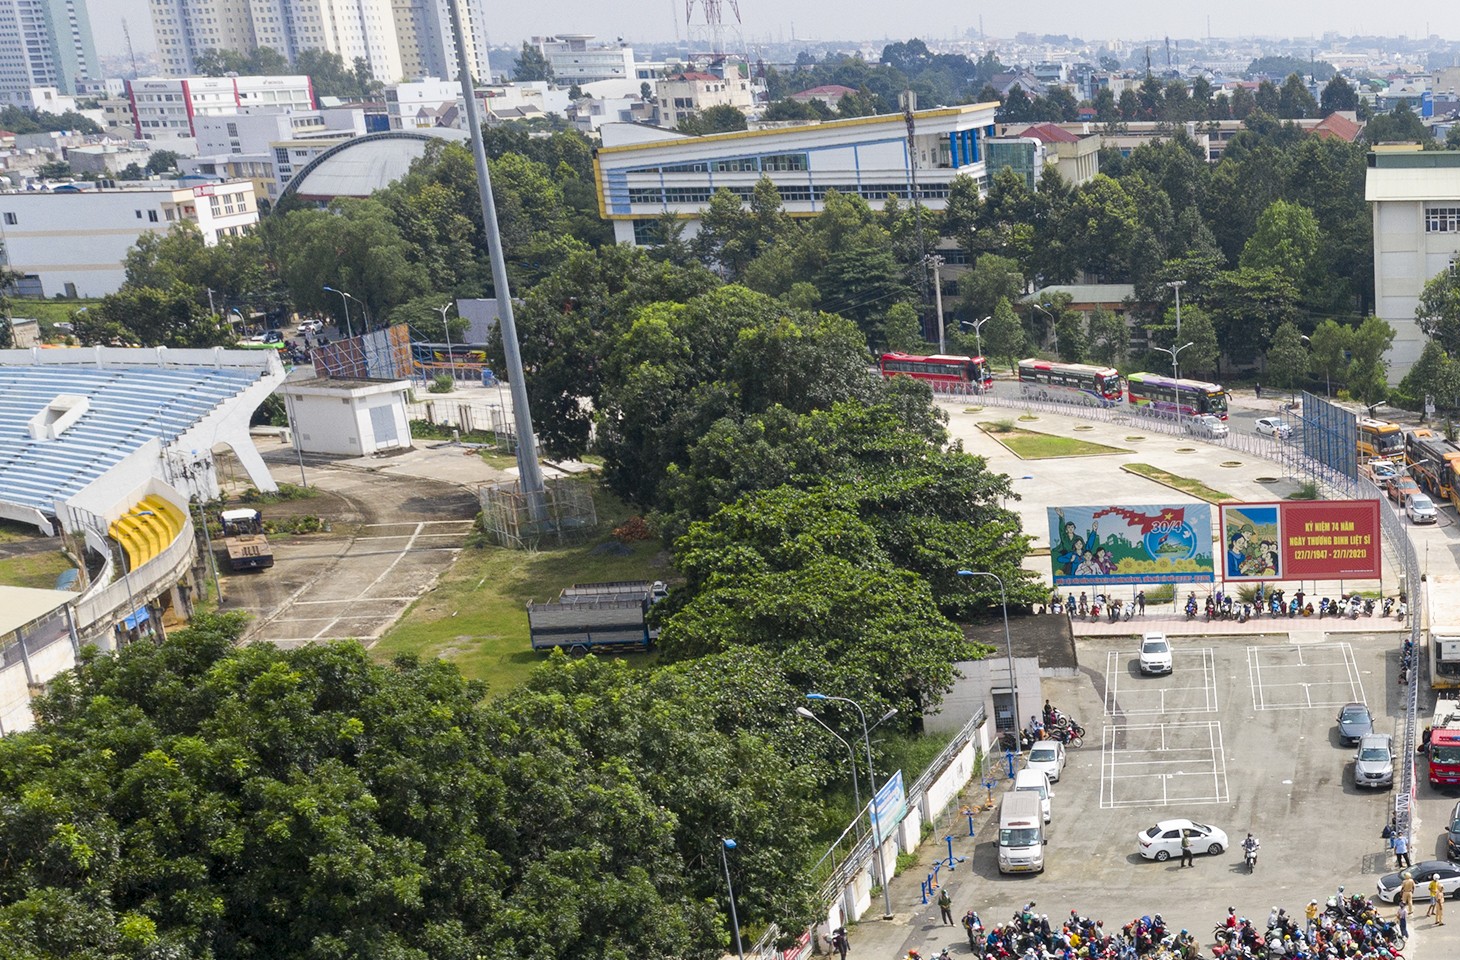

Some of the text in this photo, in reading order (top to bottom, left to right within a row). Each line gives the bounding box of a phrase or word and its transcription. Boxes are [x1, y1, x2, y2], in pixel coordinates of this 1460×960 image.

[1151, 520, 1182, 534] 30/4
[1315, 521, 1330, 533] NIỆM
[1332, 522, 1339, 531] 74
[1340, 521, 1354, 531] NĂM
[1289, 536, 1306, 546] NGÀY
[1308, 535, 1332, 546] THƯƠNG
[1333, 536, 1349, 545] BINH
[1350, 536, 1363, 546] LIỆT
[1294, 550, 1328, 560] (27/7/1947
[1333, 548, 1366, 559] 27/7/2021)
